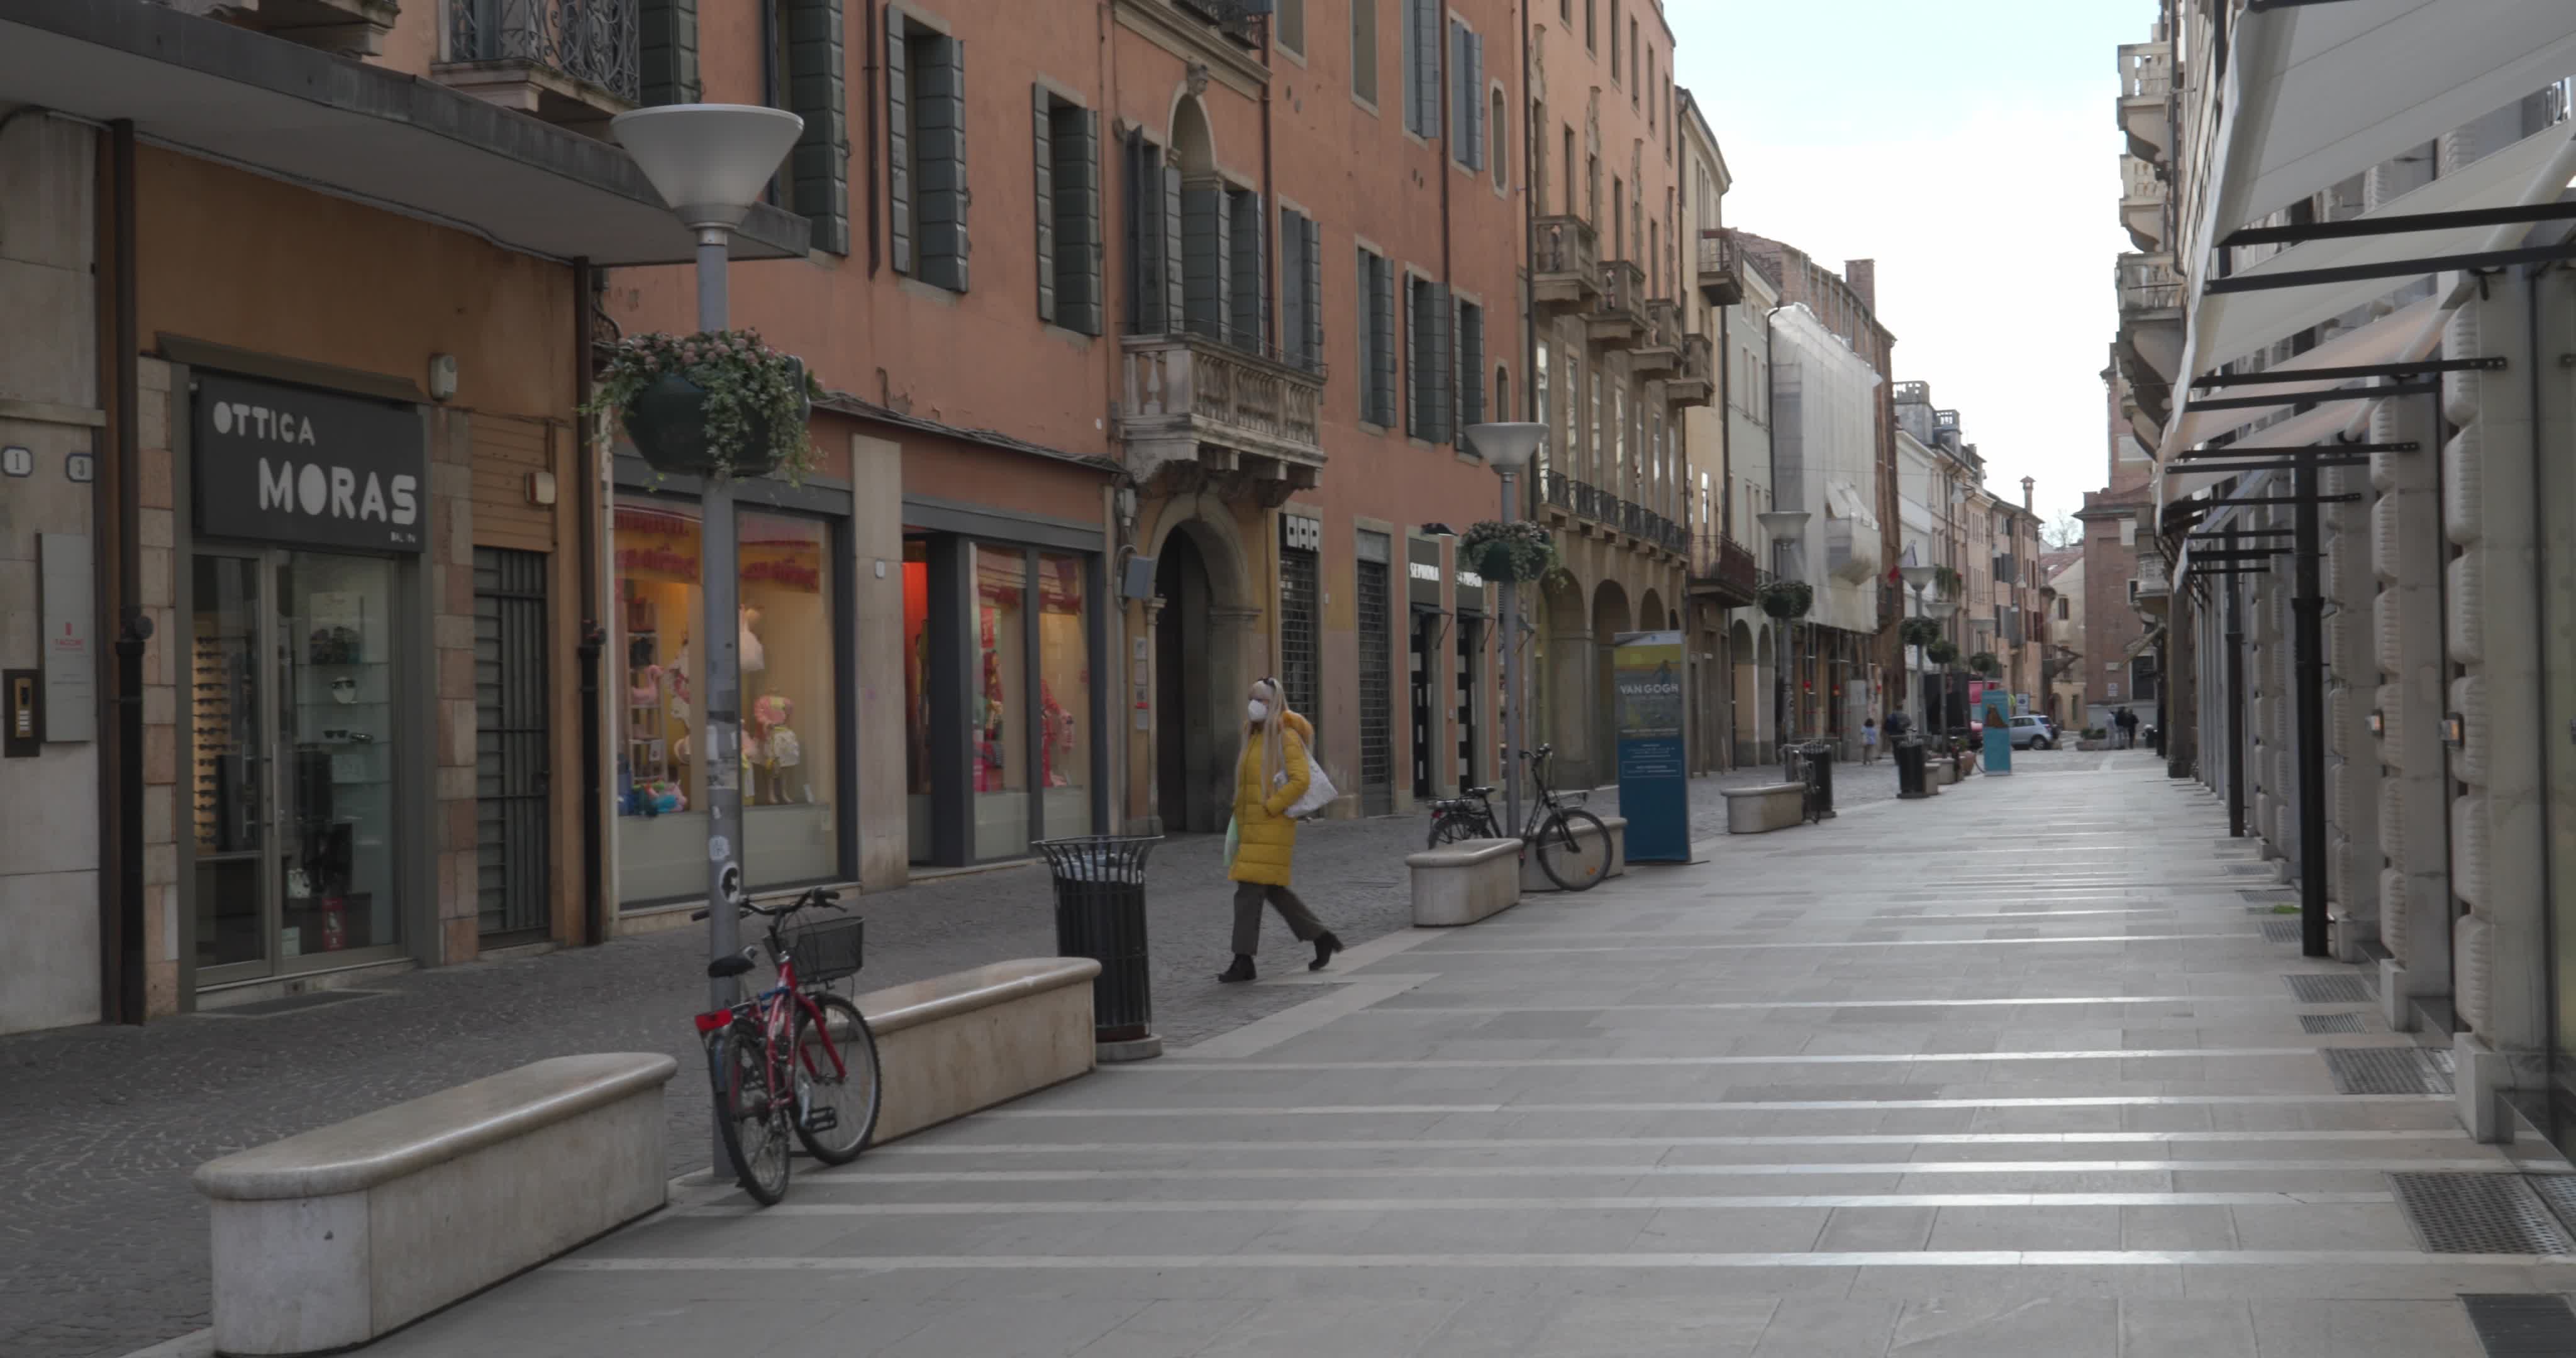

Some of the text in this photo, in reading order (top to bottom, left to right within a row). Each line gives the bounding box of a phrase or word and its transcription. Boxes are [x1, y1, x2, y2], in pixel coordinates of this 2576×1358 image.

[213, 401, 316, 446] OTTICA
[14, 453, 20, 470] 1
[258, 457, 417, 525] MORAS
[1619, 683, 1679, 695] VAN GOGH
